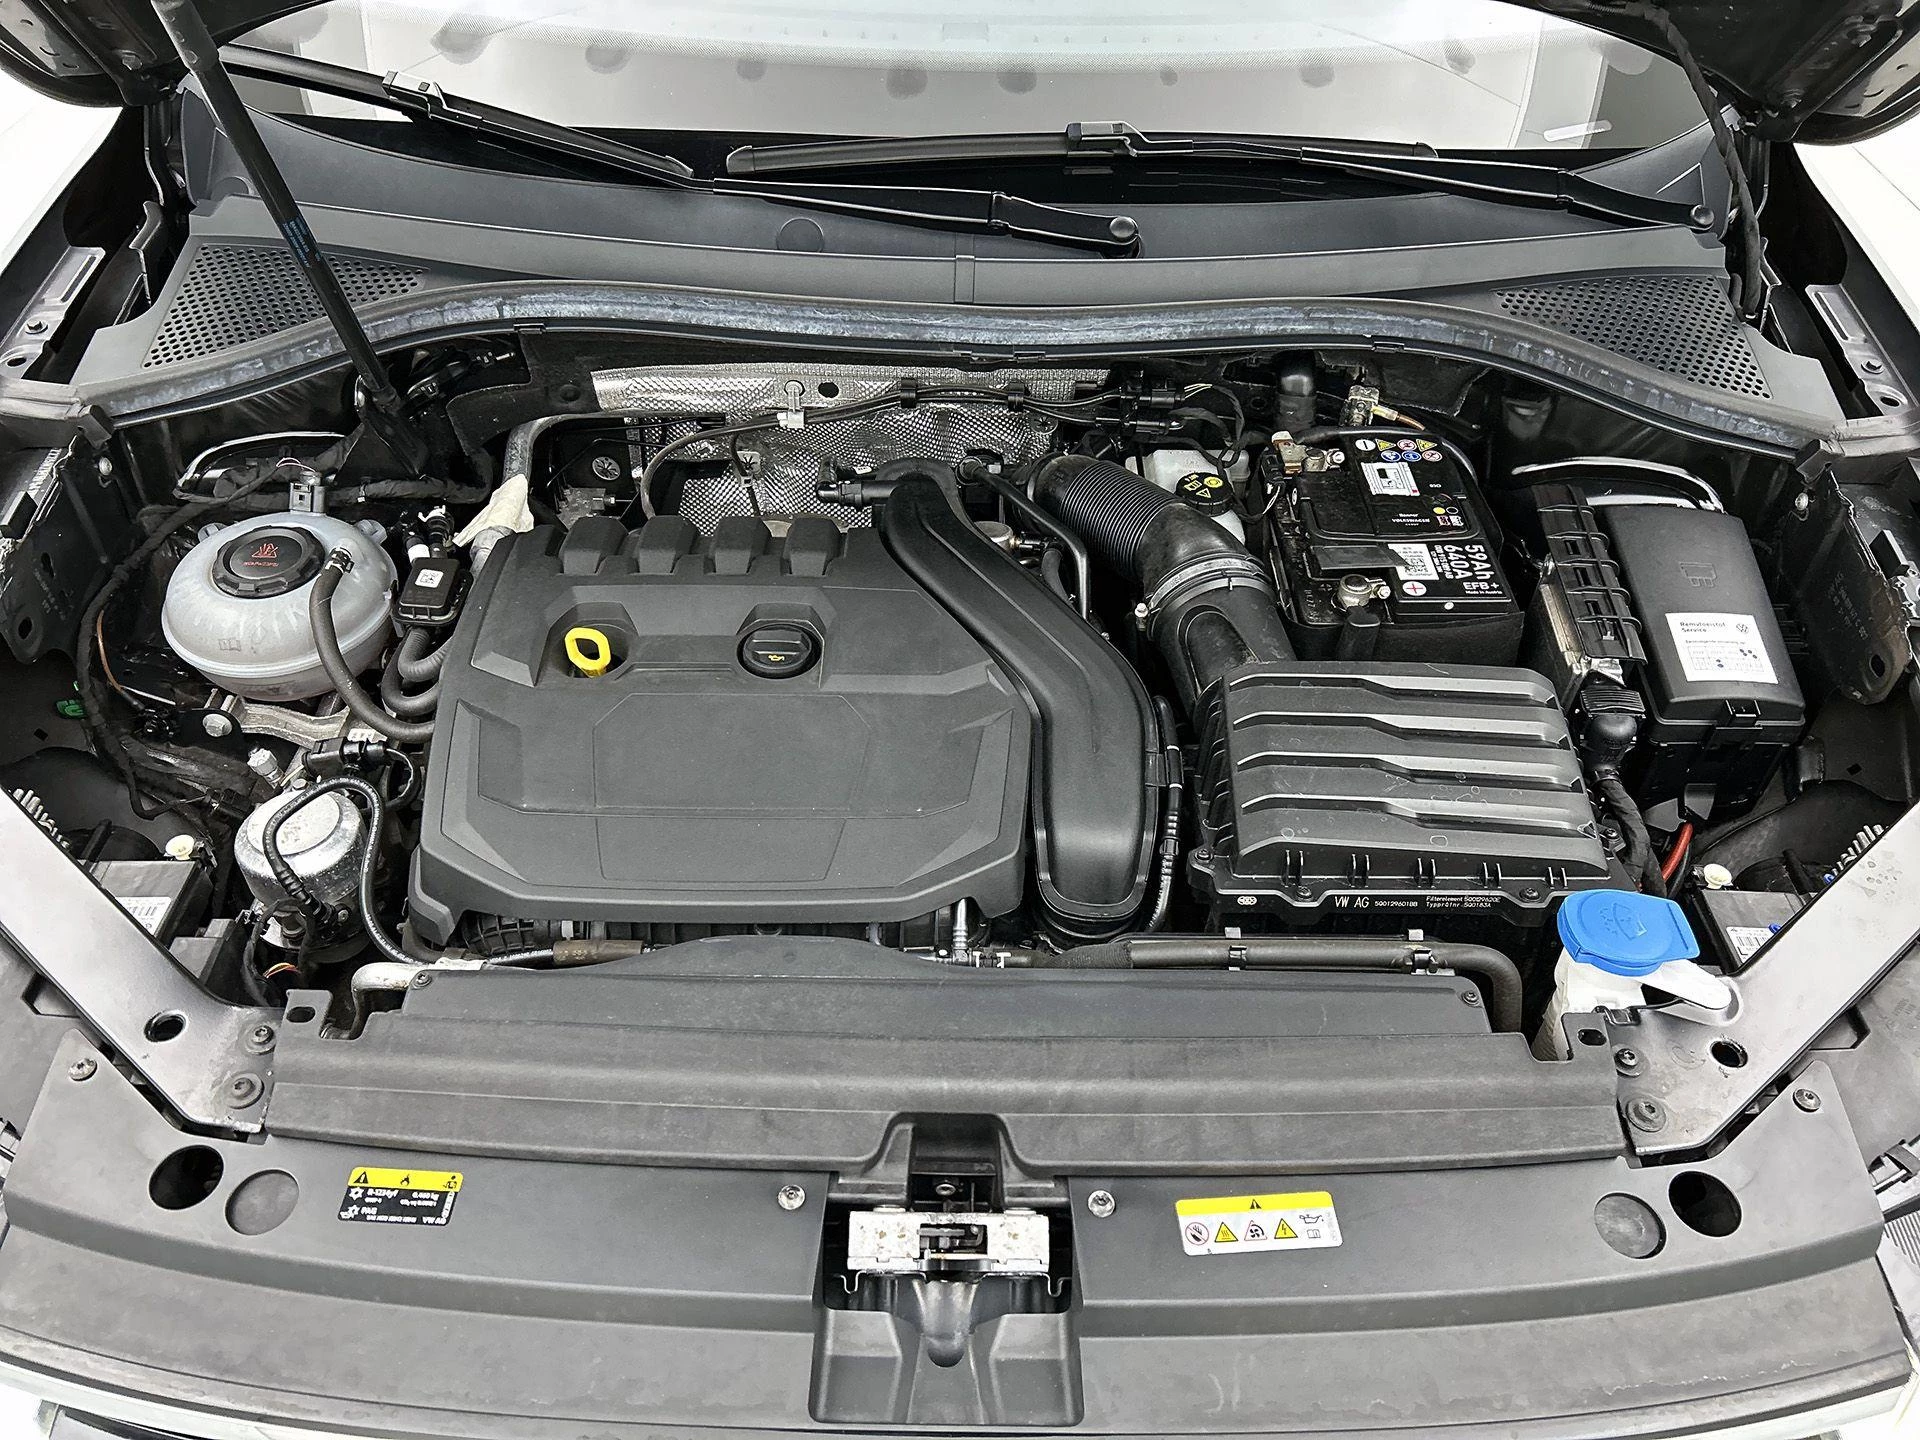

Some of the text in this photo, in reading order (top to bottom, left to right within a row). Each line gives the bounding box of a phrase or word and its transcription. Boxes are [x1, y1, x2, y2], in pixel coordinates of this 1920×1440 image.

[1443, 544, 1474, 580] 640A
[1464, 544, 1495, 580] 59Ah
[1334, 895, 1350, 908] VW
[1353, 896, 1370, 909] AG
